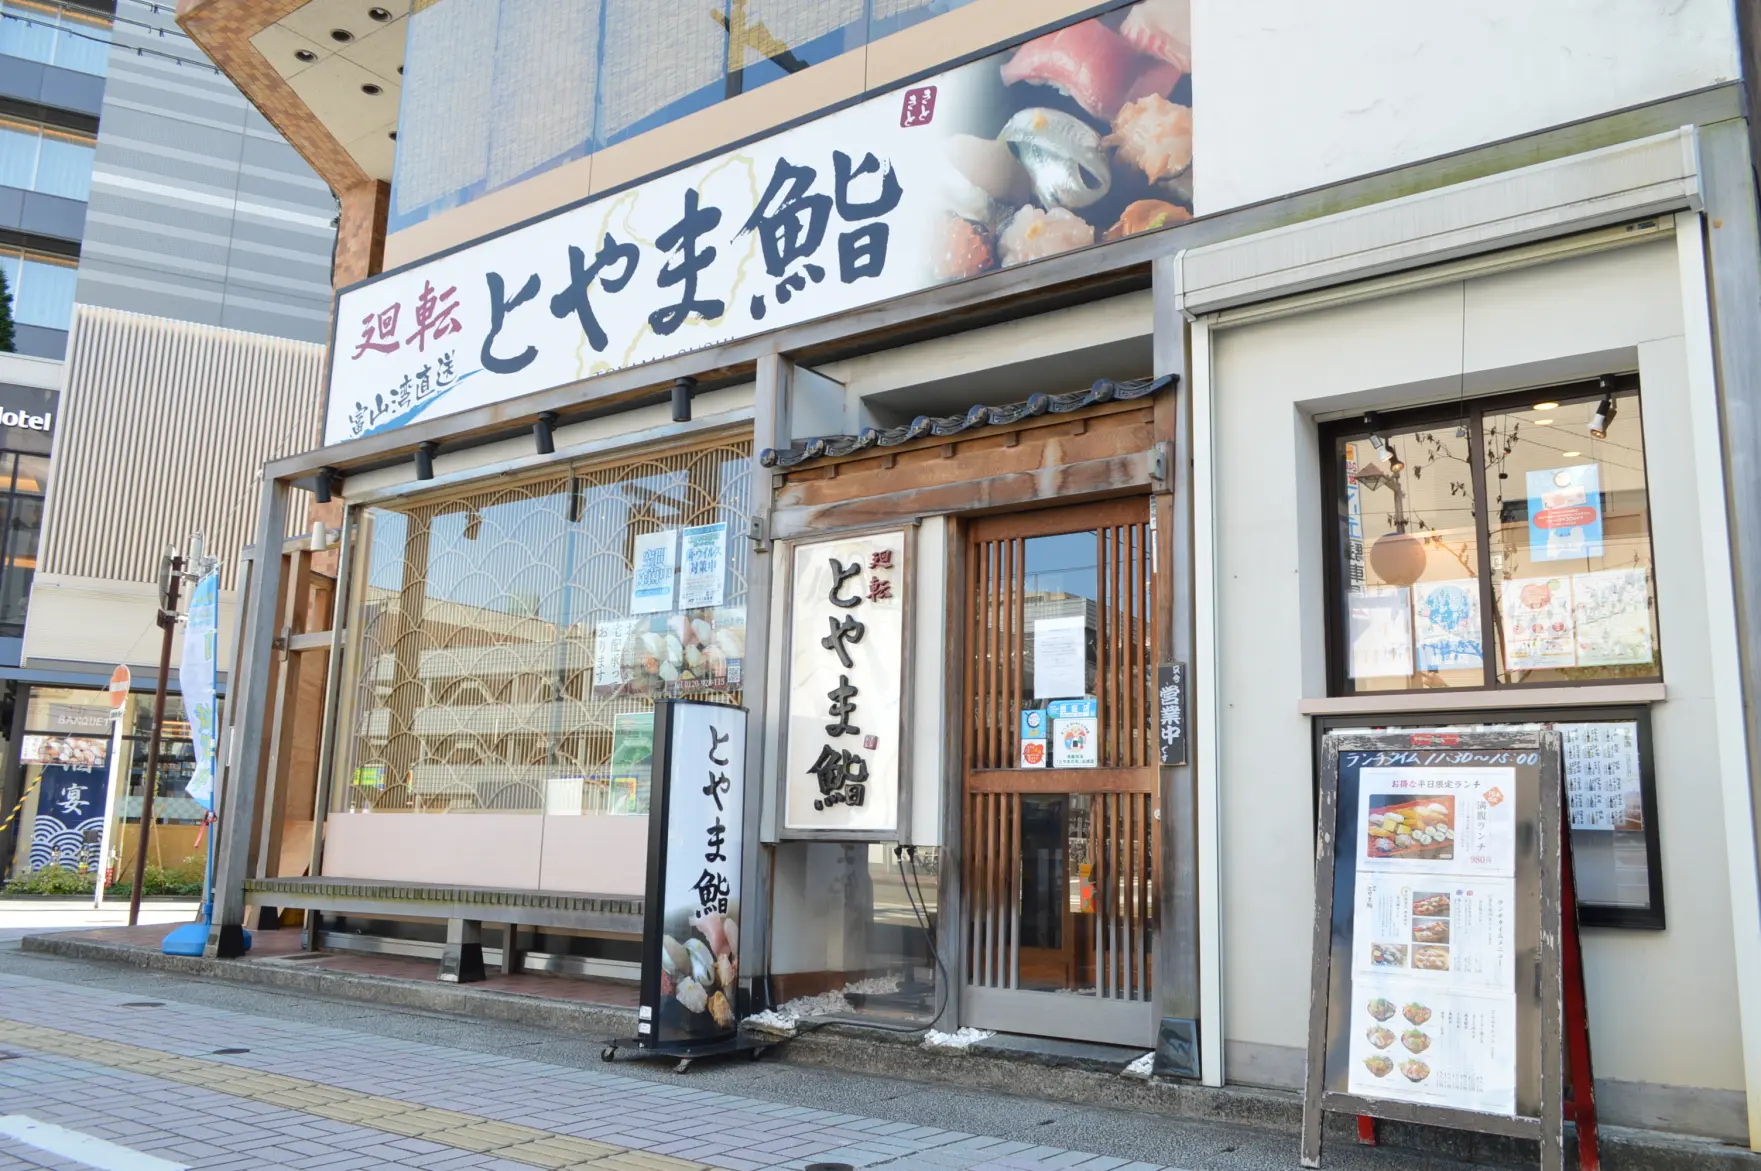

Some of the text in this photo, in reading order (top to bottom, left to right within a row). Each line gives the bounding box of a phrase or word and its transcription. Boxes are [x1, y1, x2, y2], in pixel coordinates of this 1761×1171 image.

[480, 149, 904, 375] とやま鮨
[351, 279, 463, 361] 廻転
[348, 349, 458, 438] 富山湾直送
[867, 549, 894, 603] 廻転
[806, 557, 869, 812] とやま鮨
[1159, 684, 1181, 746] 営業中
[58, 715, 111, 727] BANQUET
[1346, 752, 1422, 768] ランチタイム
[1391, 779, 1481, 790] お得な平日限定ランチ
[688, 724, 731, 919] とやま鮨
